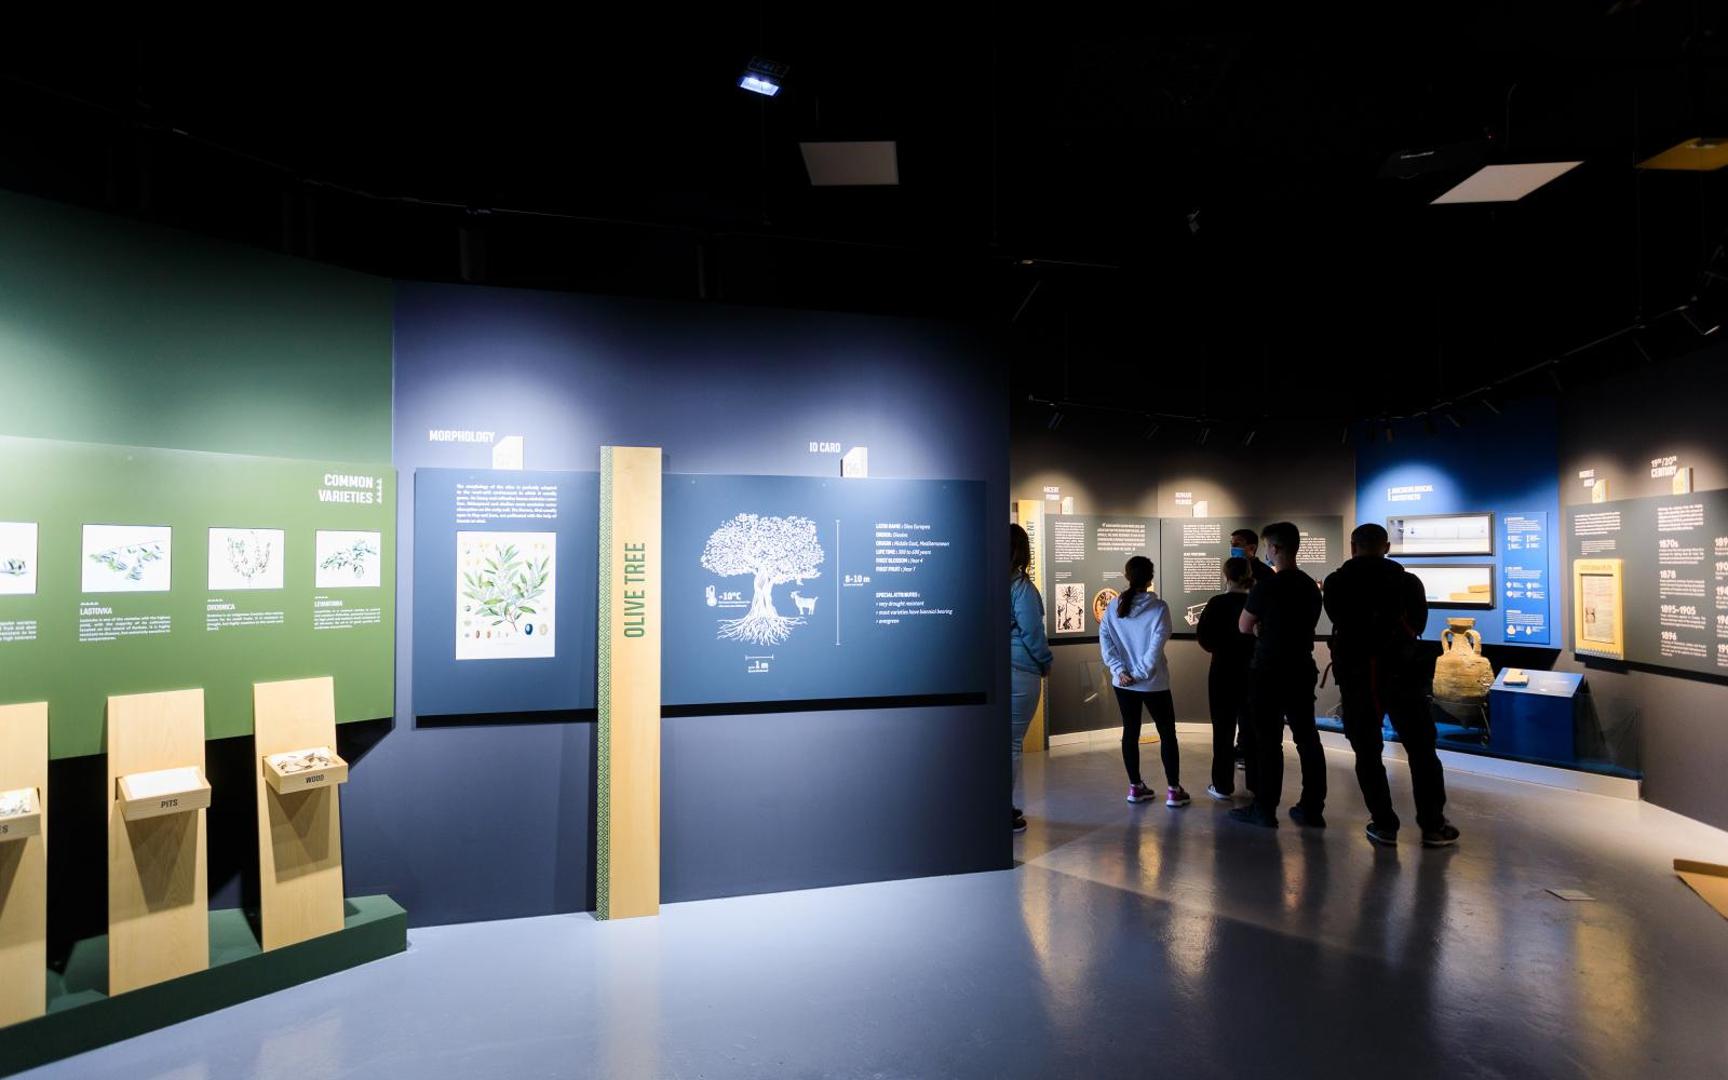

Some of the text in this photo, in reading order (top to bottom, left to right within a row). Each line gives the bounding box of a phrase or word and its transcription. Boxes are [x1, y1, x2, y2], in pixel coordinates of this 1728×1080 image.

[429, 430, 496, 443] MORPHOLOGY
[809, 441, 841, 453] ID CARD
[324, 474, 373, 488] COMMON
[318, 489, 374, 504] VARIETIES
[844, 574, 863, 583] 8-10
[624, 543, 645, 638] OLIVE TREE
[718, 591, 742, 601] -10°C
[305, 774, 325, 784] WOOD
[160, 798, 178, 809] PITS
[0, 824, 9, 834] S
